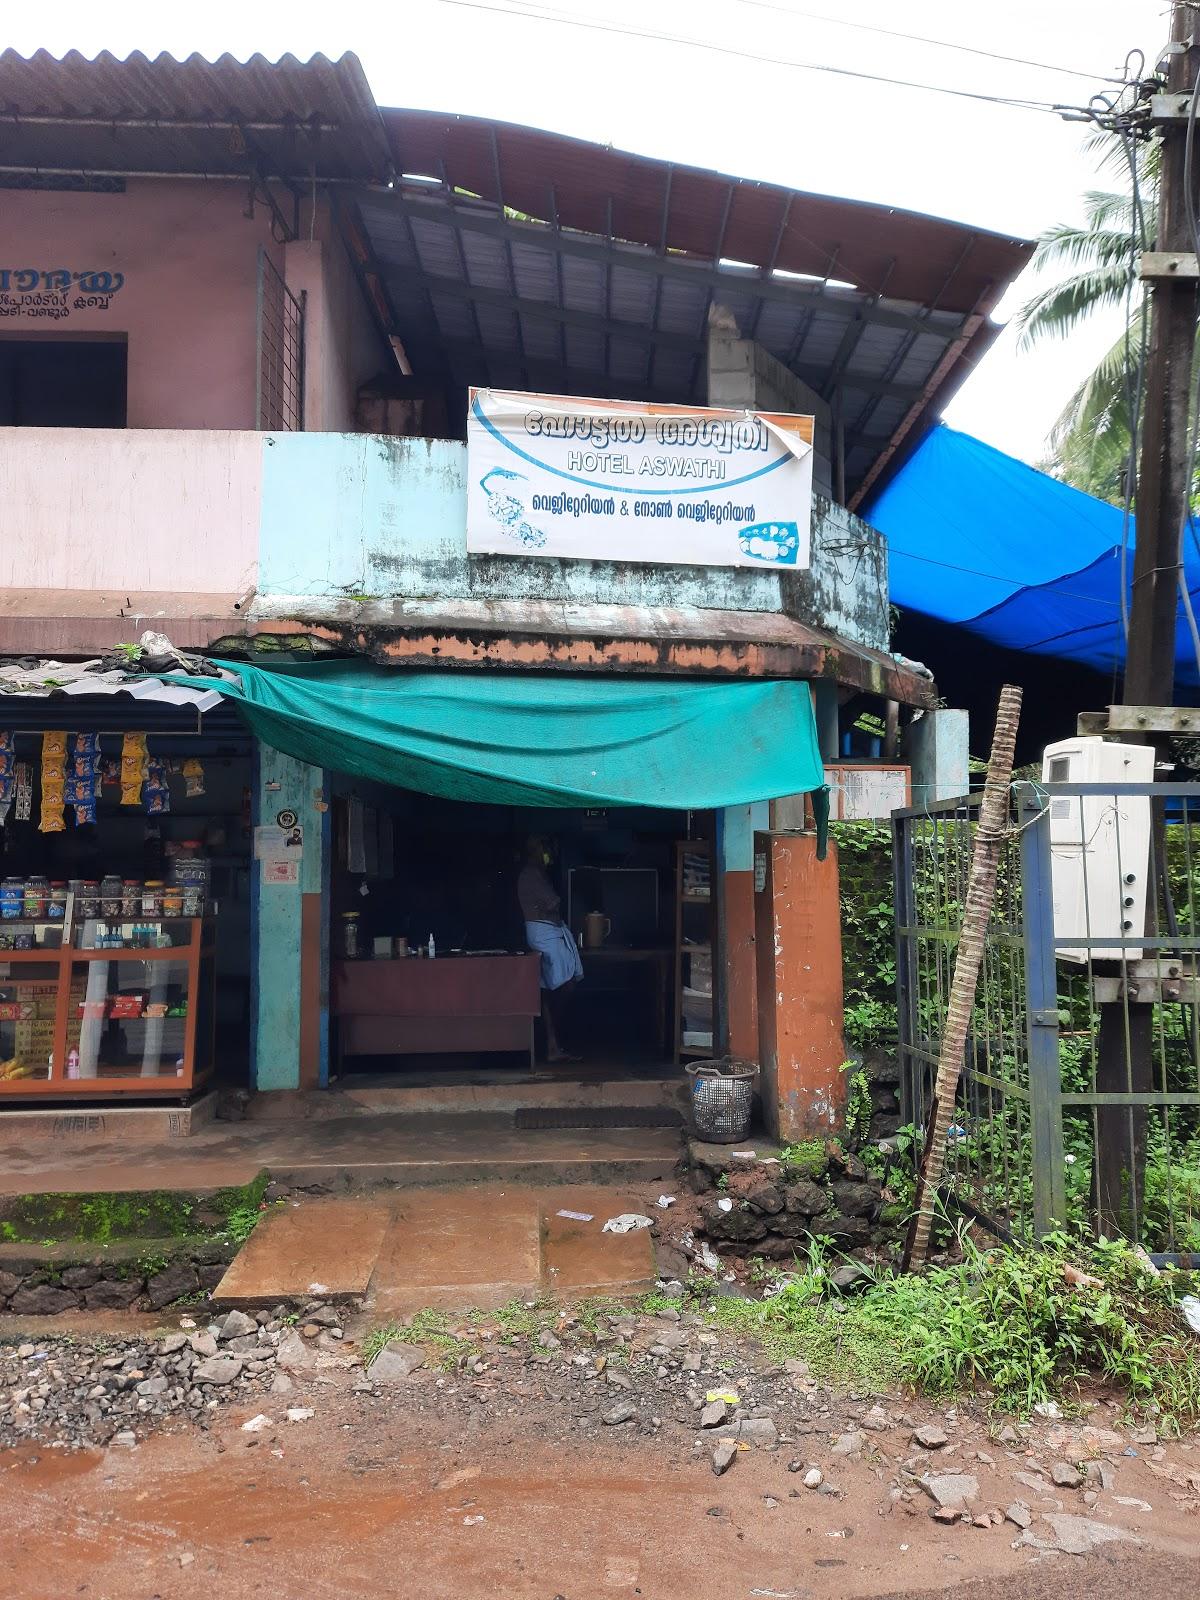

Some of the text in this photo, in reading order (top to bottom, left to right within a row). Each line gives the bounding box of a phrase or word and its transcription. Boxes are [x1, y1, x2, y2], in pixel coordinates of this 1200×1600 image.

[524, 410, 769, 454] ഹോട്ടൽ അശ്വതി
[567, 450, 727, 480] HOTEL ASWATHI
[532, 491, 756, 525] വെജിറ്റേറിയൻ & നോൺ വെജിറ്റേറിയൻ
